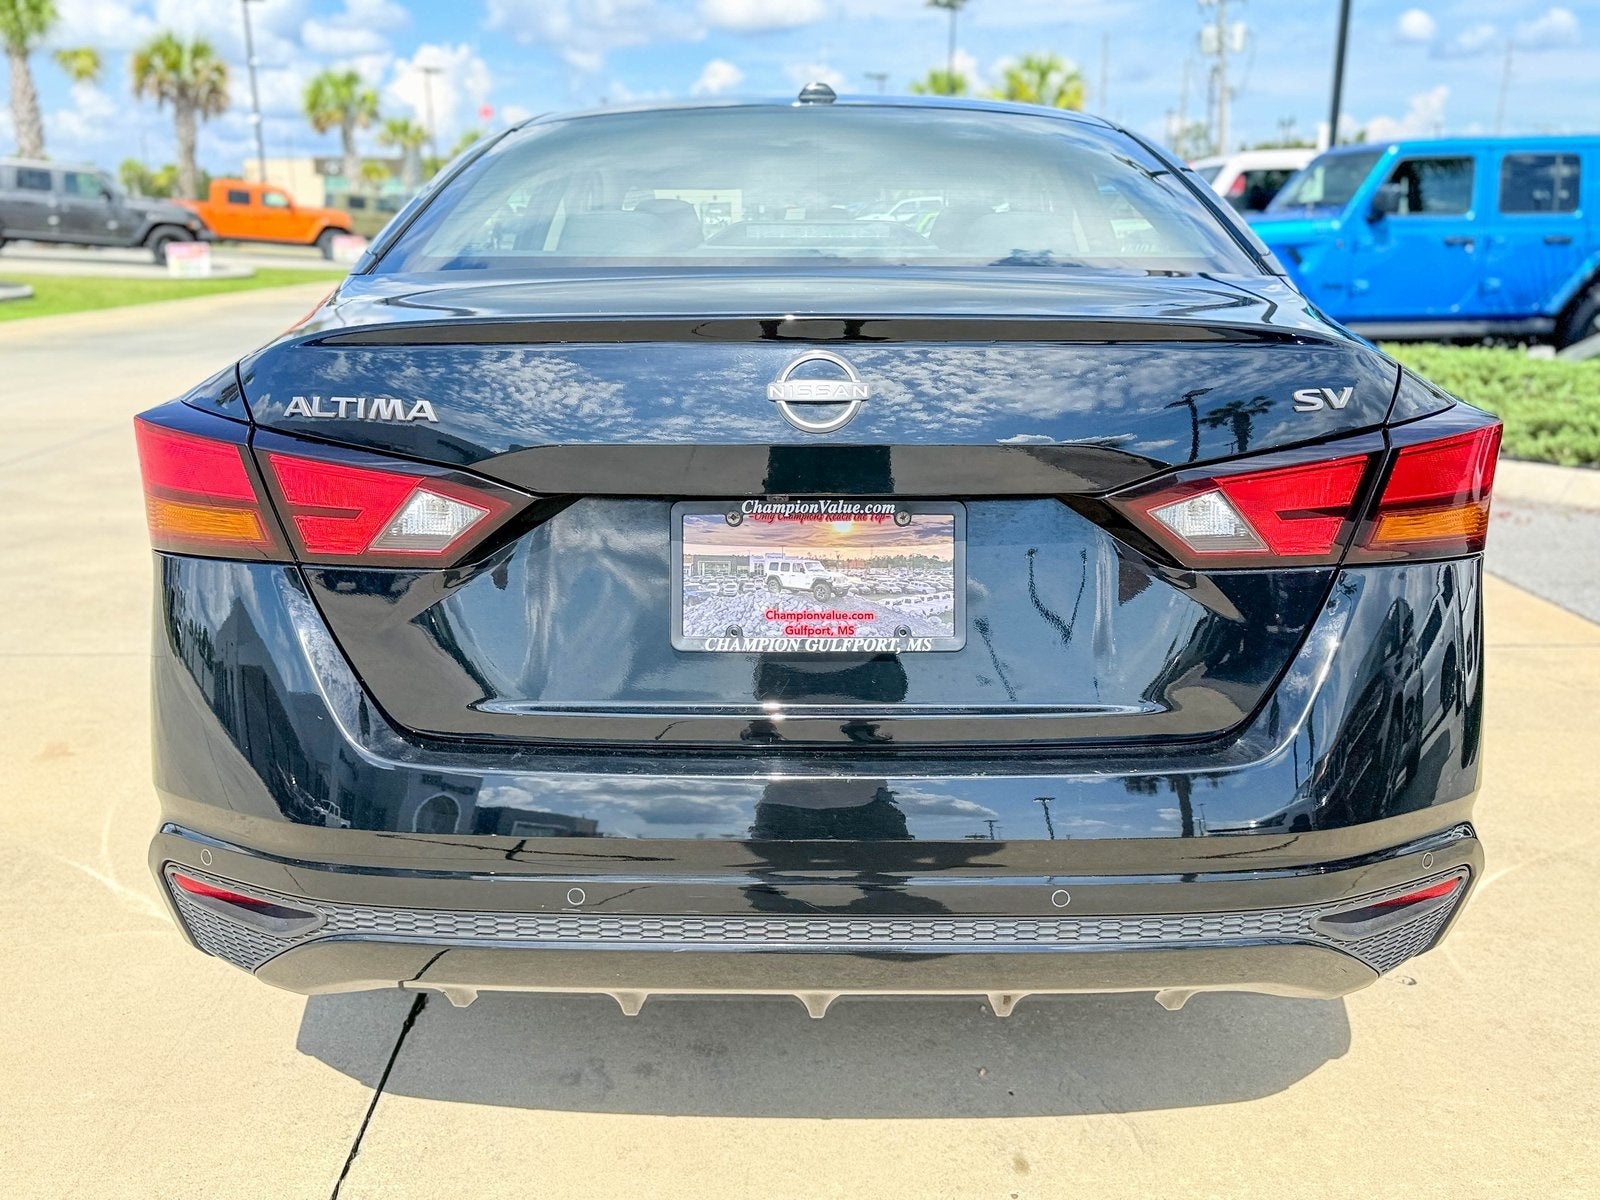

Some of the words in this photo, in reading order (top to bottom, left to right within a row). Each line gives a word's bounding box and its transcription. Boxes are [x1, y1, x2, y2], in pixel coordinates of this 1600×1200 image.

[769, 384, 868, 398] NISSAN
[1292, 386, 1354, 412] SV
[283, 396, 440, 423] ALTIMA
[741, 500, 896, 517] ChampionValue.com
[765, 610, 874, 622] Championvalue.com
[785, 625, 835, 636] Gulfport,
[837, 626, 855, 635] MS
[704, 638, 800, 652] CHAMPION
[804, 638, 902, 654] GULFPORT,
[906, 638, 933, 652] MS
